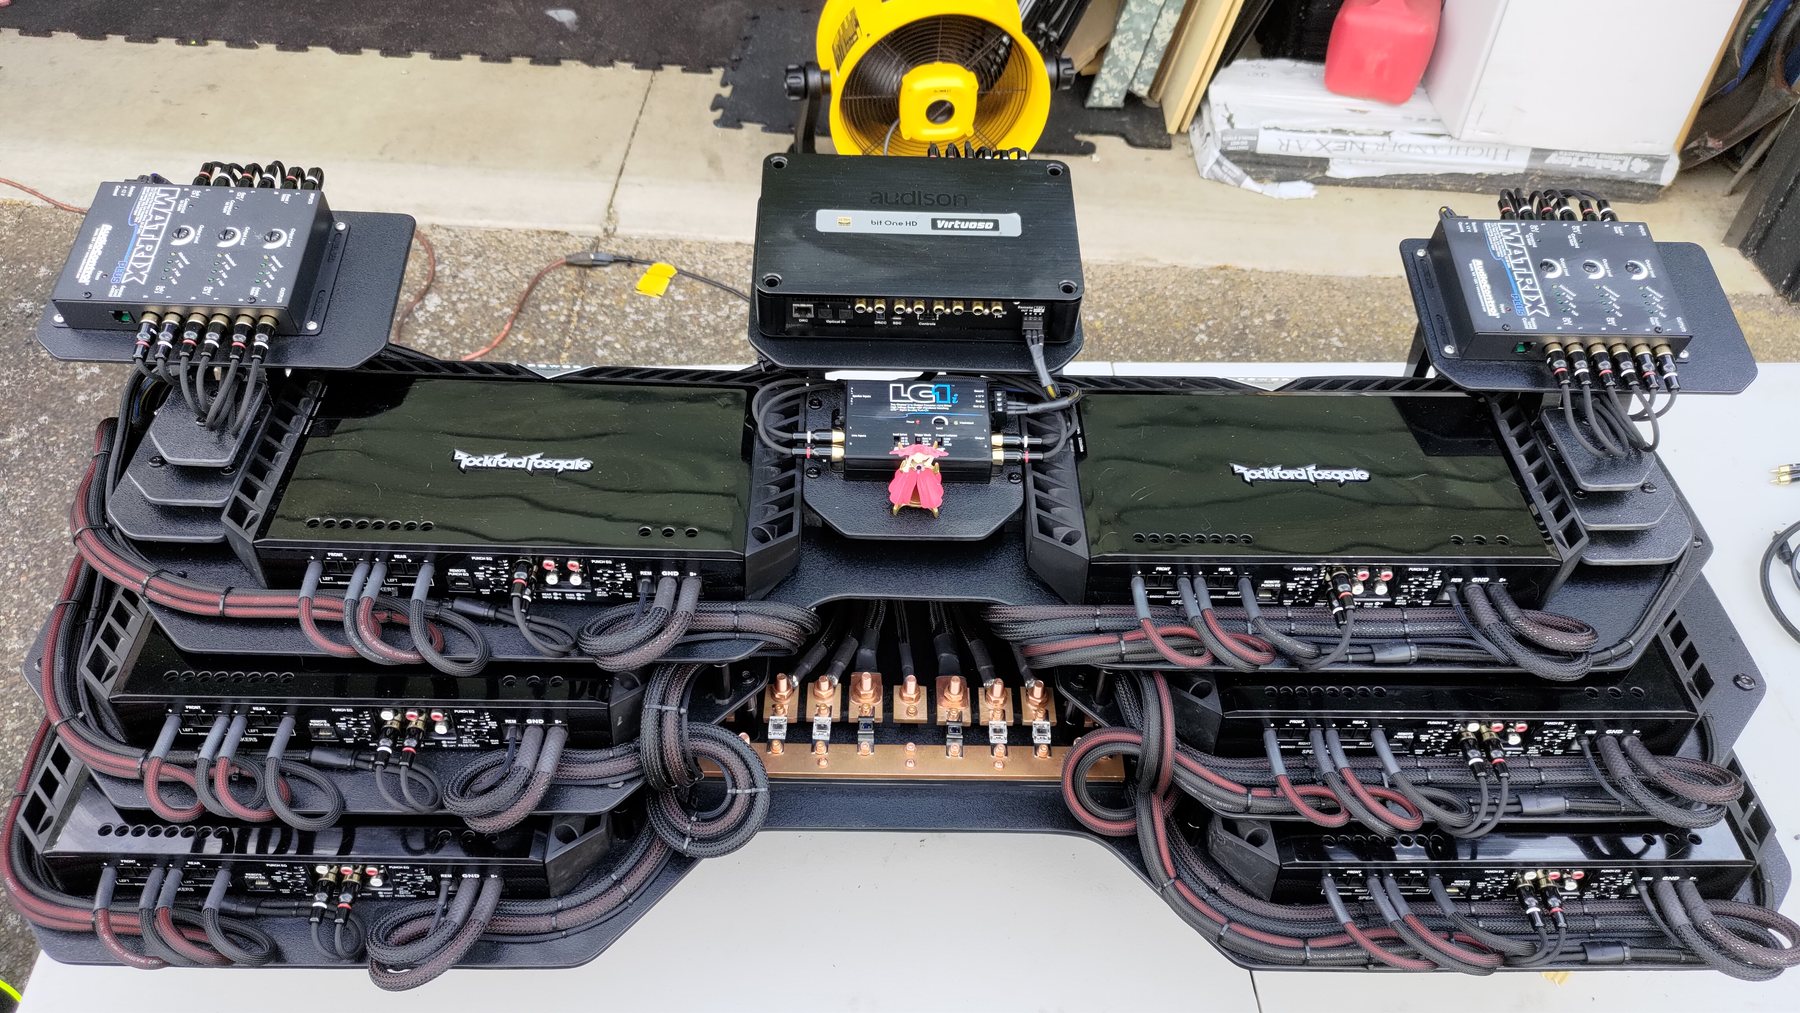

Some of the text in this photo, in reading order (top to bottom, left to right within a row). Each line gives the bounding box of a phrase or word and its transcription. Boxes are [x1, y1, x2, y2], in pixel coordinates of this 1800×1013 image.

[870, 190, 968, 207] audison
[121, 187, 180, 285] MATRIX
[936, 219, 994, 230] Virtuoso
[110, 260, 128, 284] PLUS
[1498, 222, 1550, 318] MATRIX
[1472, 259, 1500, 318] AudioControl
[1511, 293, 1528, 317] PLUS
[454, 449, 594, 473] Rockford Fosgate
[1230, 463, 1370, 483] Rockford Fosgate
